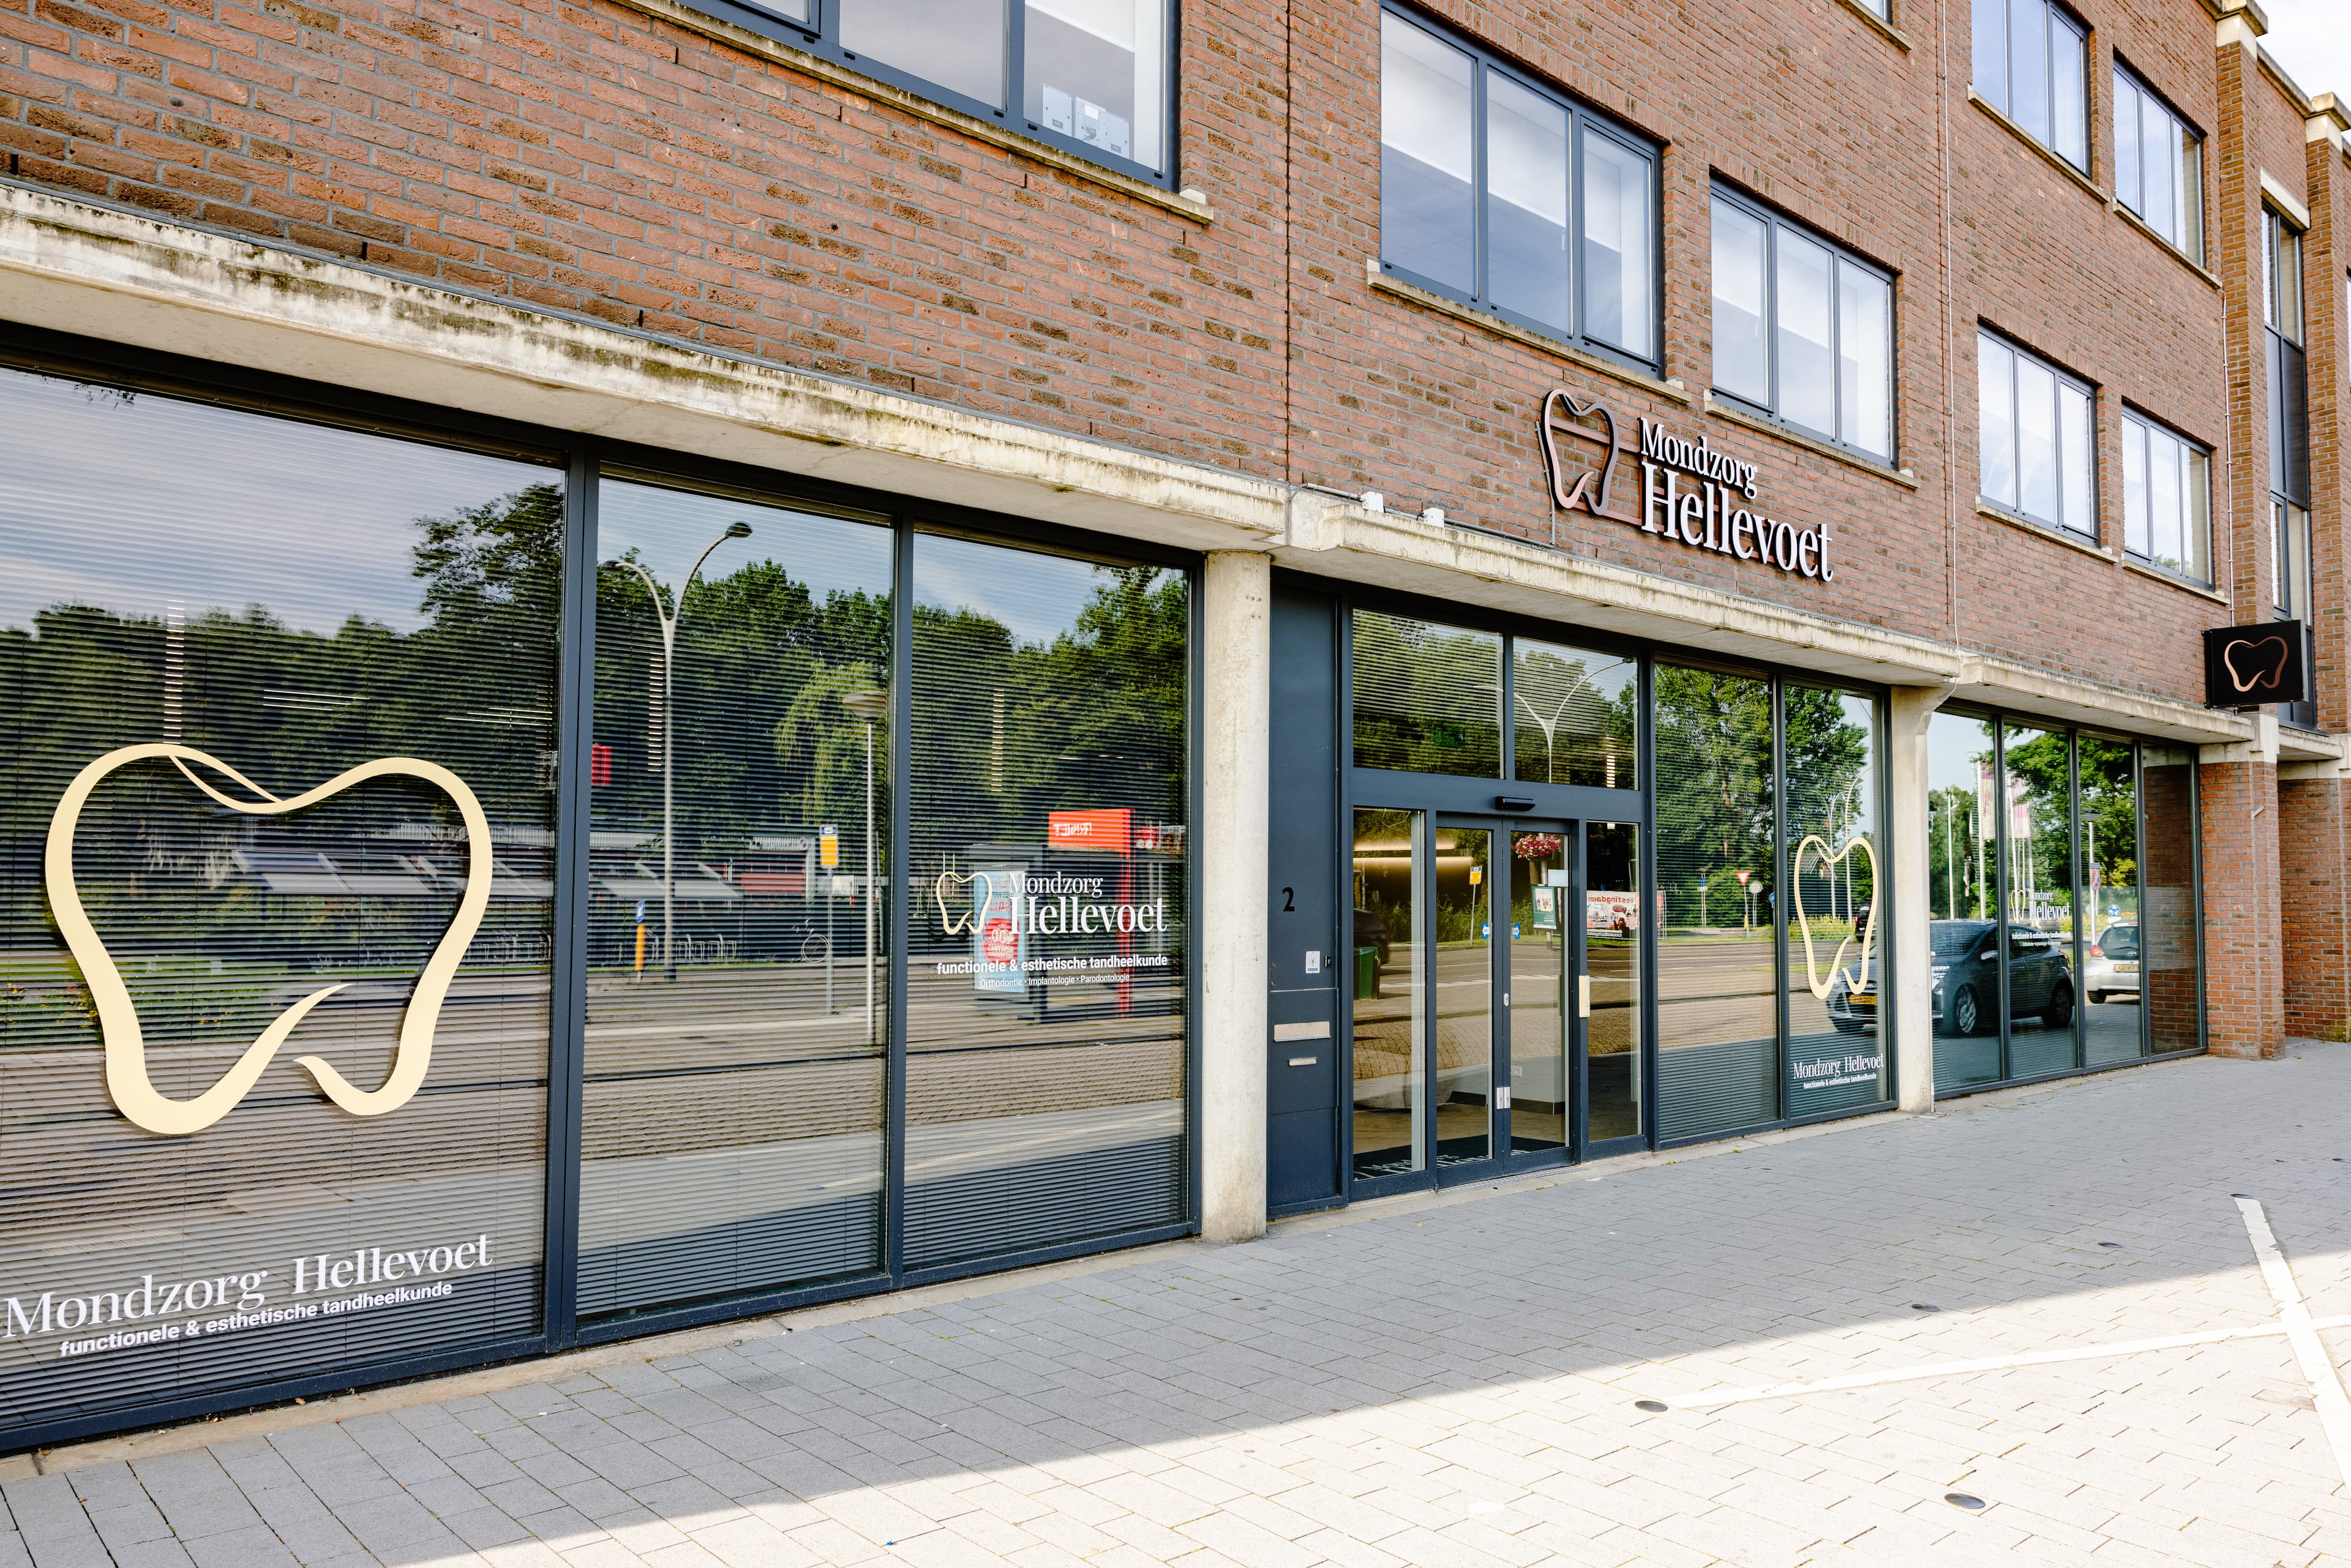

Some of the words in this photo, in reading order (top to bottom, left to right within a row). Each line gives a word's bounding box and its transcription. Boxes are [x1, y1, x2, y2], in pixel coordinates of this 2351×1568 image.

[1638, 417, 1758, 498] Mondzorg
[1641, 461, 1833, 582] Hellevoet
[1008, 871, 1103, 898] Mondzorg
[1283, 887, 1294, 911] 2
[2030, 901, 2070, 920] Hellevoet
[1008, 897, 1168, 934] Hellevoet
[937, 959, 1005, 974] functionele
[1010, 959, 1018, 971] &
[1021, 956, 1087, 971] esthetische
[1090, 953, 1168, 969] tandheelkunde
[980, 978, 1022, 988] Orthodontie
[1029, 976, 1075, 987] Implantologie
[1081, 973, 1130, 984] Parodontologie
[1793, 1059, 1841, 1079] Mondzorg
[1845, 1053, 1884, 1072] Hellevoet
[1804, 1079, 1825, 1089] functionele
[1829, 1076, 1851, 1085] esthetische
[1851, 1072, 1877, 1082] tandheelkunde
[2, 1270, 268, 1338] Mondzorg
[293, 1234, 492, 1295] Hellevoet
[59, 1323, 179, 1357] functionele
[185, 1320, 200, 1336] &
[206, 1301, 318, 1333] esthetische
[323, 1281, 453, 1315] tandheelkunde
